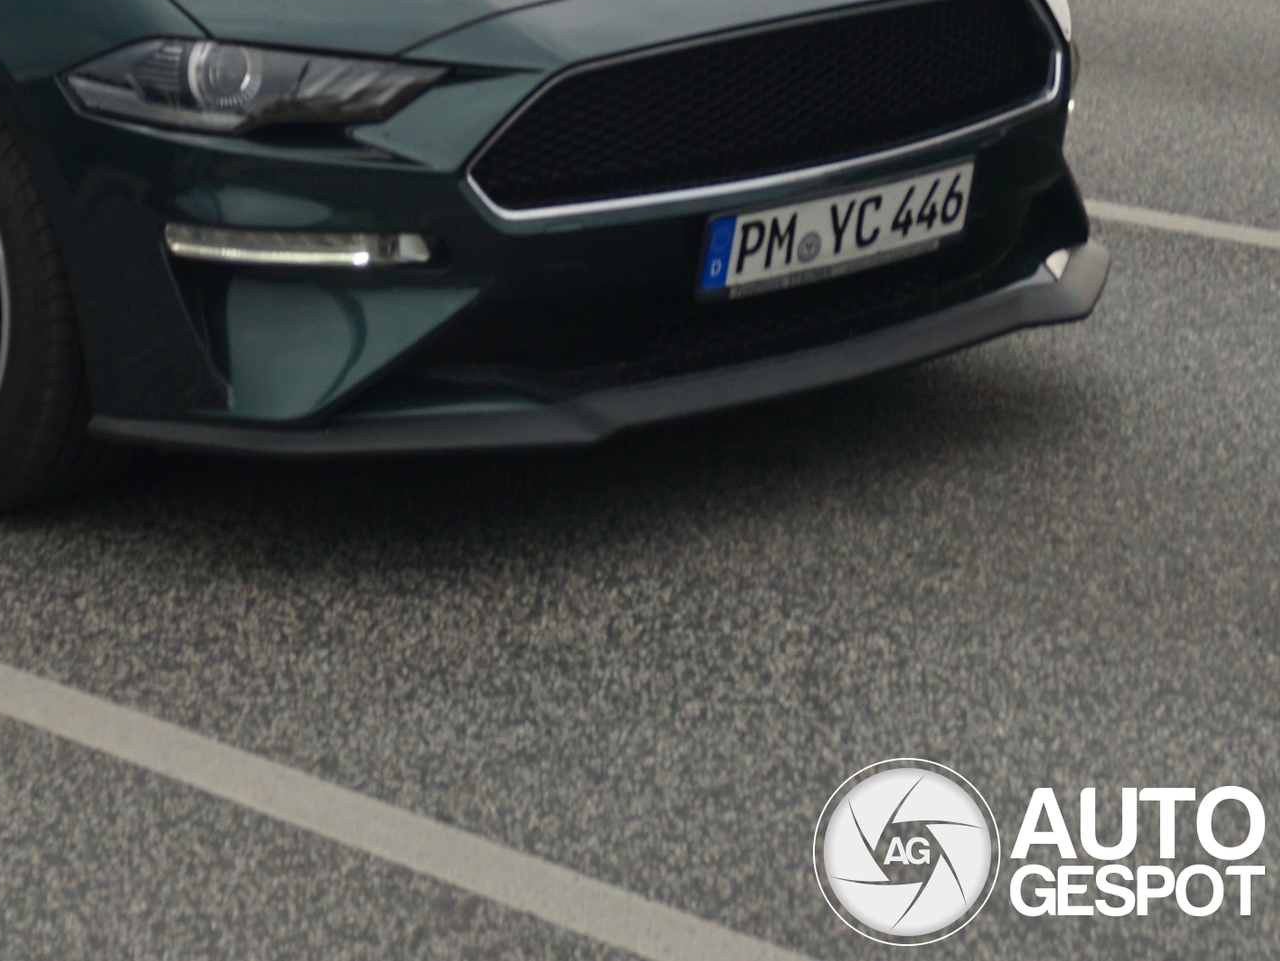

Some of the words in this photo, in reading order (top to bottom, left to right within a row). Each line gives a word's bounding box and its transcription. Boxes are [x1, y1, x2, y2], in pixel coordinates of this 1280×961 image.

[735, 212, 798, 274] PM
[830, 195, 883, 254] YC
[890, 172, 964, 237] 446
